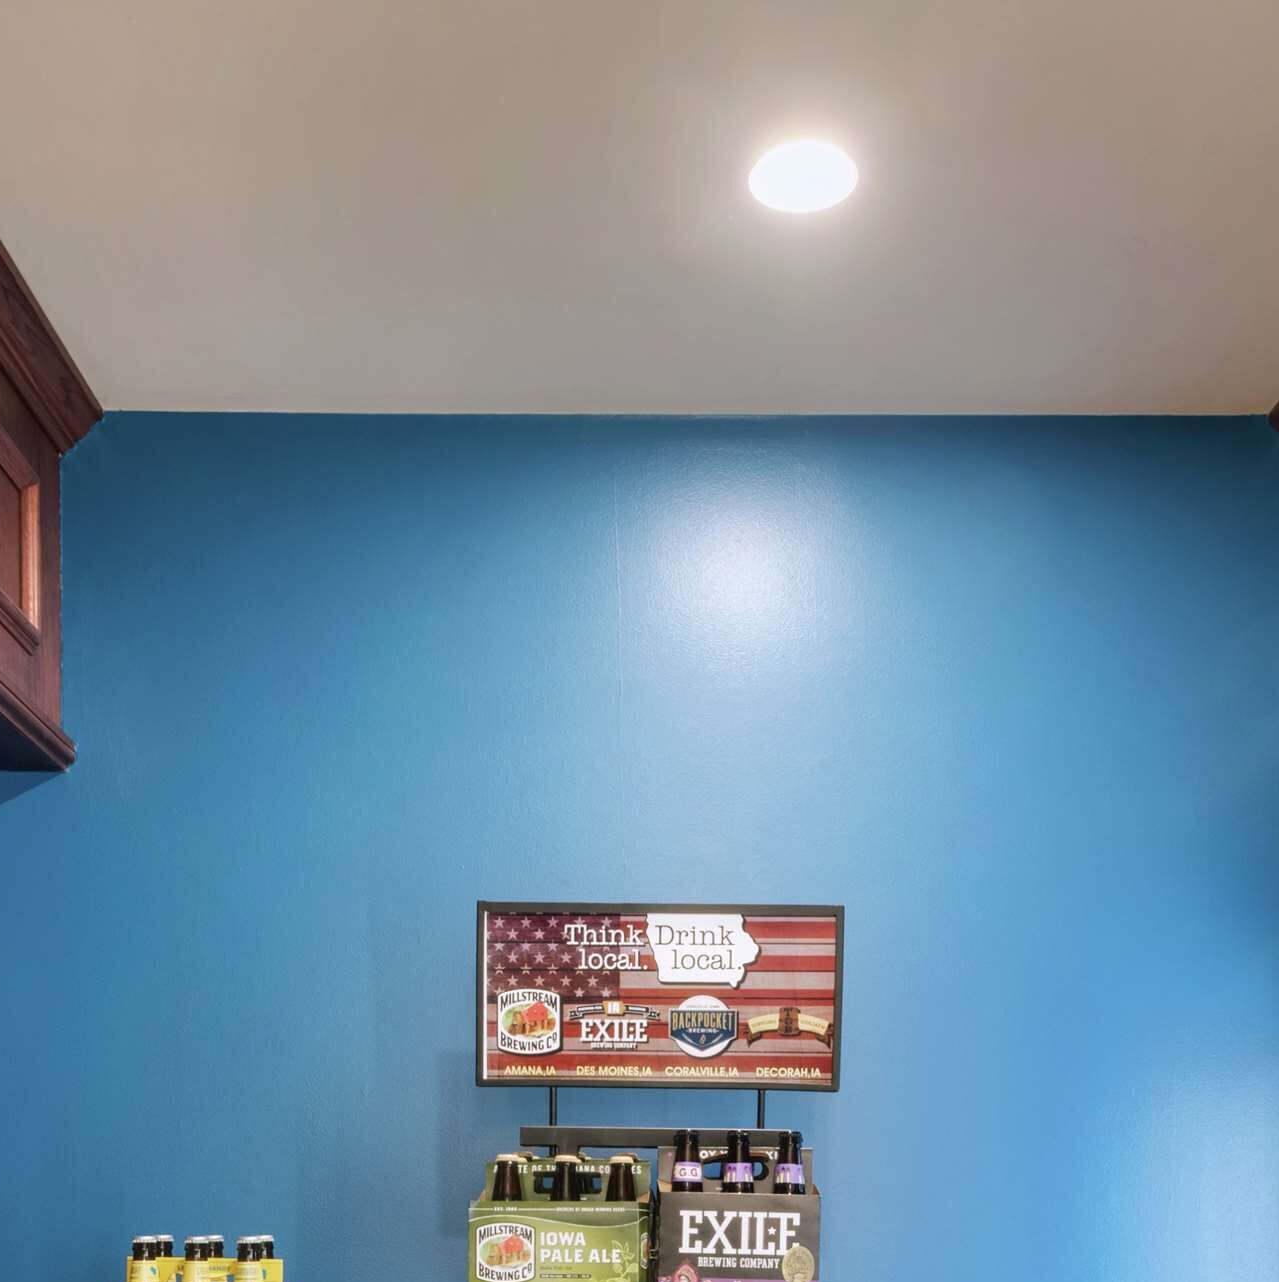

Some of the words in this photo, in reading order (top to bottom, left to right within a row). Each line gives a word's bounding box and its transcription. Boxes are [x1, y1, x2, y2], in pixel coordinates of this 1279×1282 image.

[564, 924, 643, 947] Think
[655, 924, 735, 946] Drink
[579, 949, 648, 970] local.
[671, 949, 741, 970] local.
[500, 991, 558, 1012] MILLSTREAM
[580, 1019, 648, 1042] EXILE
[672, 1012, 733, 1031] BACKPOCKET
[500, 1032, 544, 1050] BREWING
[576, 1066, 595, 1076] DES
[478, 1225, 533, 1245] MILLSTREAM
[540, 1232, 586, 1246] IOWA
[678, 1210, 800, 1255] EXILE
[540, 1249, 584, 1264] PALE
[588, 1249, 621, 1264] ALE
[698, 1256, 736, 1268] BREWING
[739, 1257, 780, 1270] COMPANY
[478, 1263, 520, 1282] BREWING
